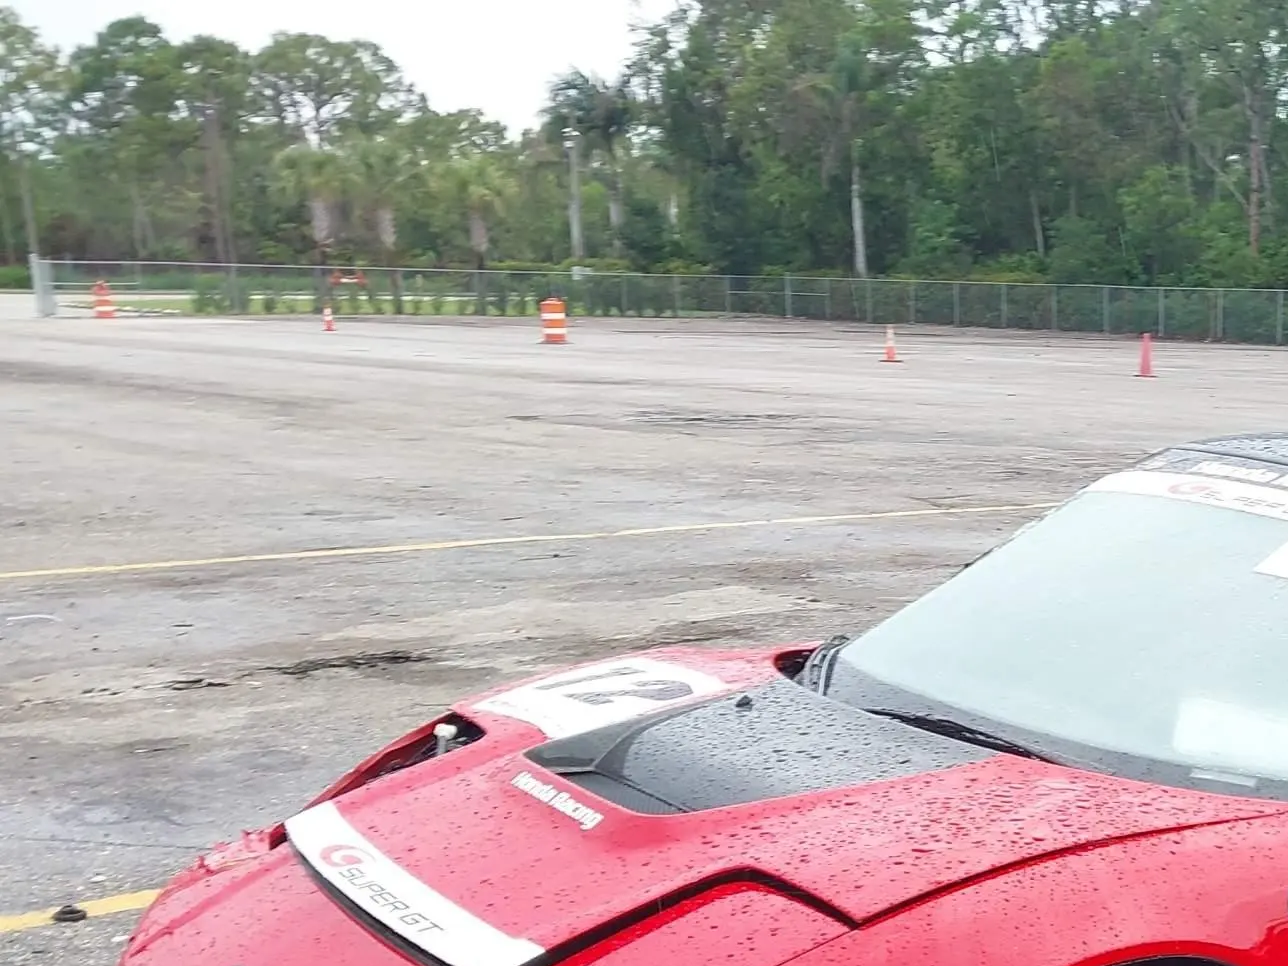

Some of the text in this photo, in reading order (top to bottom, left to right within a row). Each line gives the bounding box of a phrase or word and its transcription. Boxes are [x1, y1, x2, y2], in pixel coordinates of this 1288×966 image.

[510, 770, 605, 831] Honda Racing
[338, 867, 410, 913] SUPER
[398, 912, 445, 932] GT
